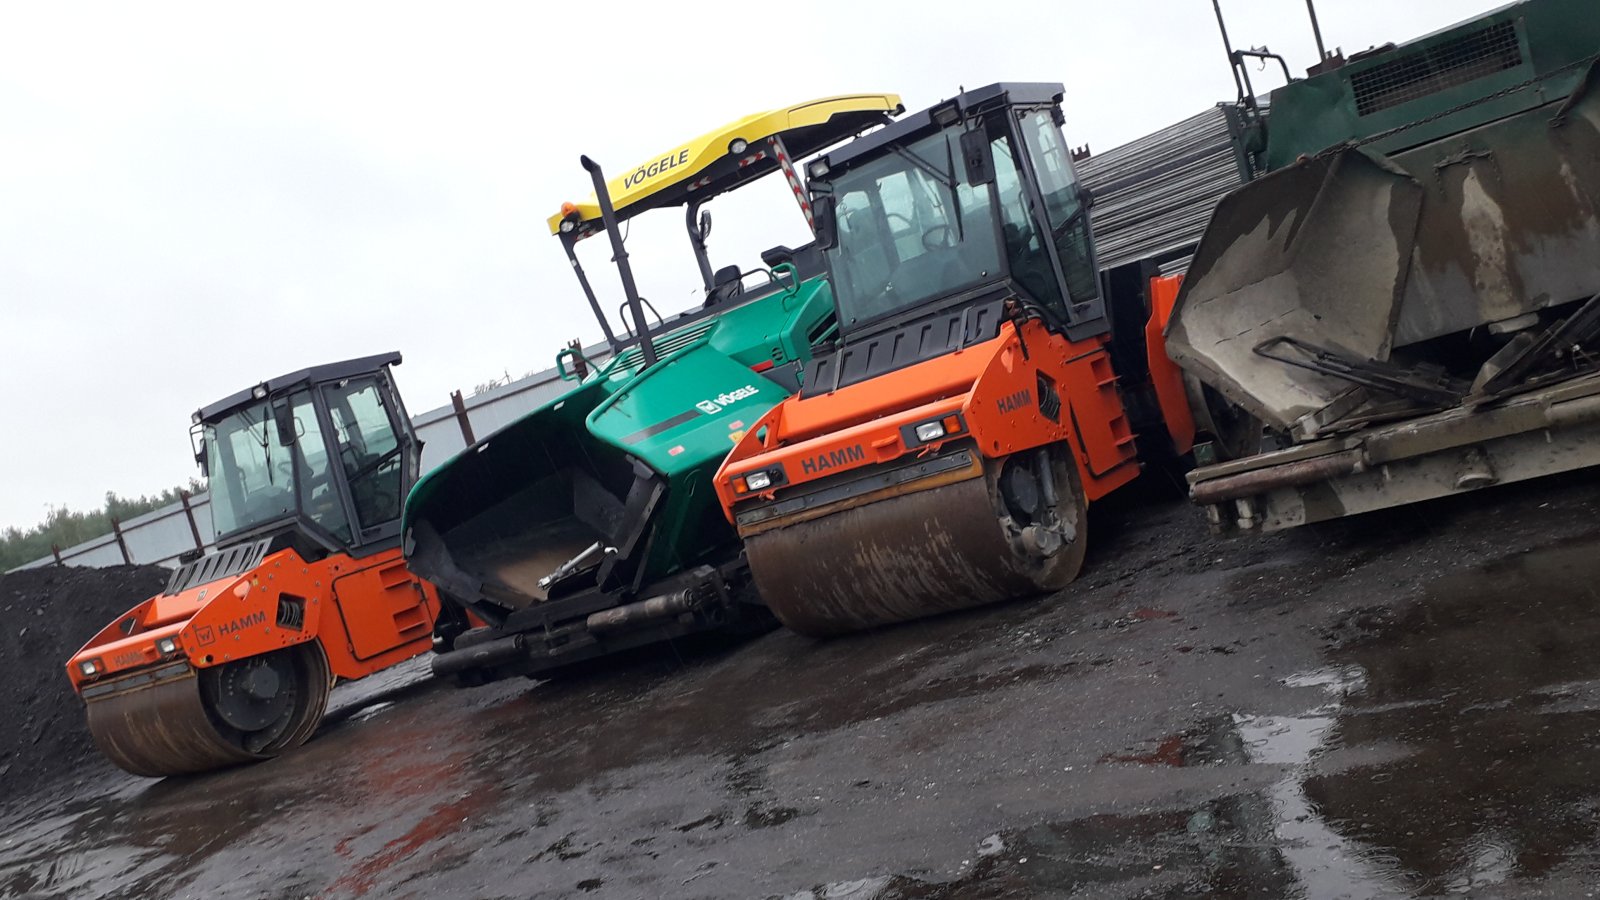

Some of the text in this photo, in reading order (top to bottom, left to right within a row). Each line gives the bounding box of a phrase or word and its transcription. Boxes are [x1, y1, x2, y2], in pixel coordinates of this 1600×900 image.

[624, 149, 689, 189] VÖGELE
[714, 385, 759, 406] VÖGELE
[997, 389, 1031, 415] HAMM
[802, 444, 865, 474] HAMM
[218, 611, 266, 636] HAMM
